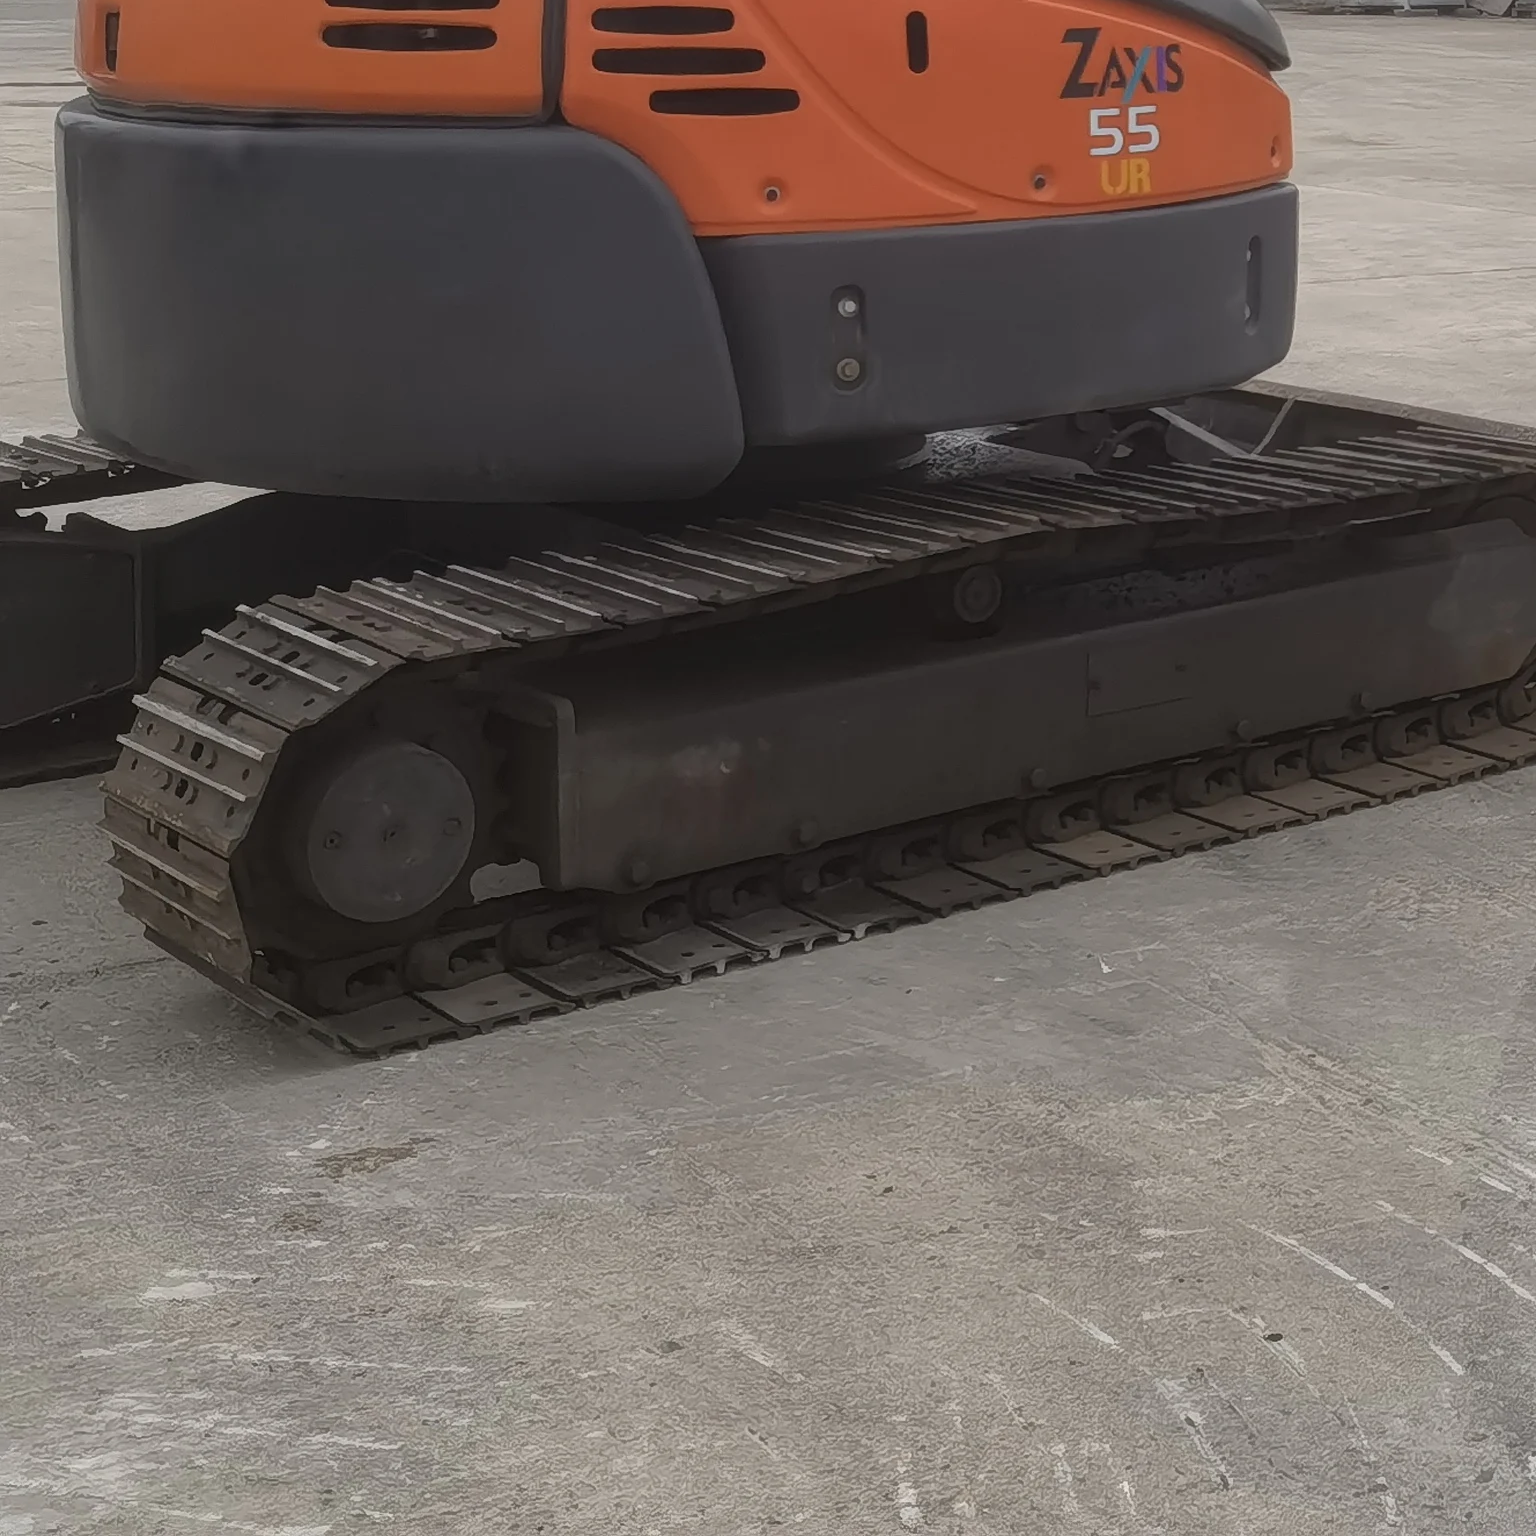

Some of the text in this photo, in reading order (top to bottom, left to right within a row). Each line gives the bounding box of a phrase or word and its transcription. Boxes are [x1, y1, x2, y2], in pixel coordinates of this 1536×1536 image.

[1060, 27, 1185, 104] ZAXIS
[1089, 105, 1160, 156] 55
[1101, 157, 1152, 195] UR
